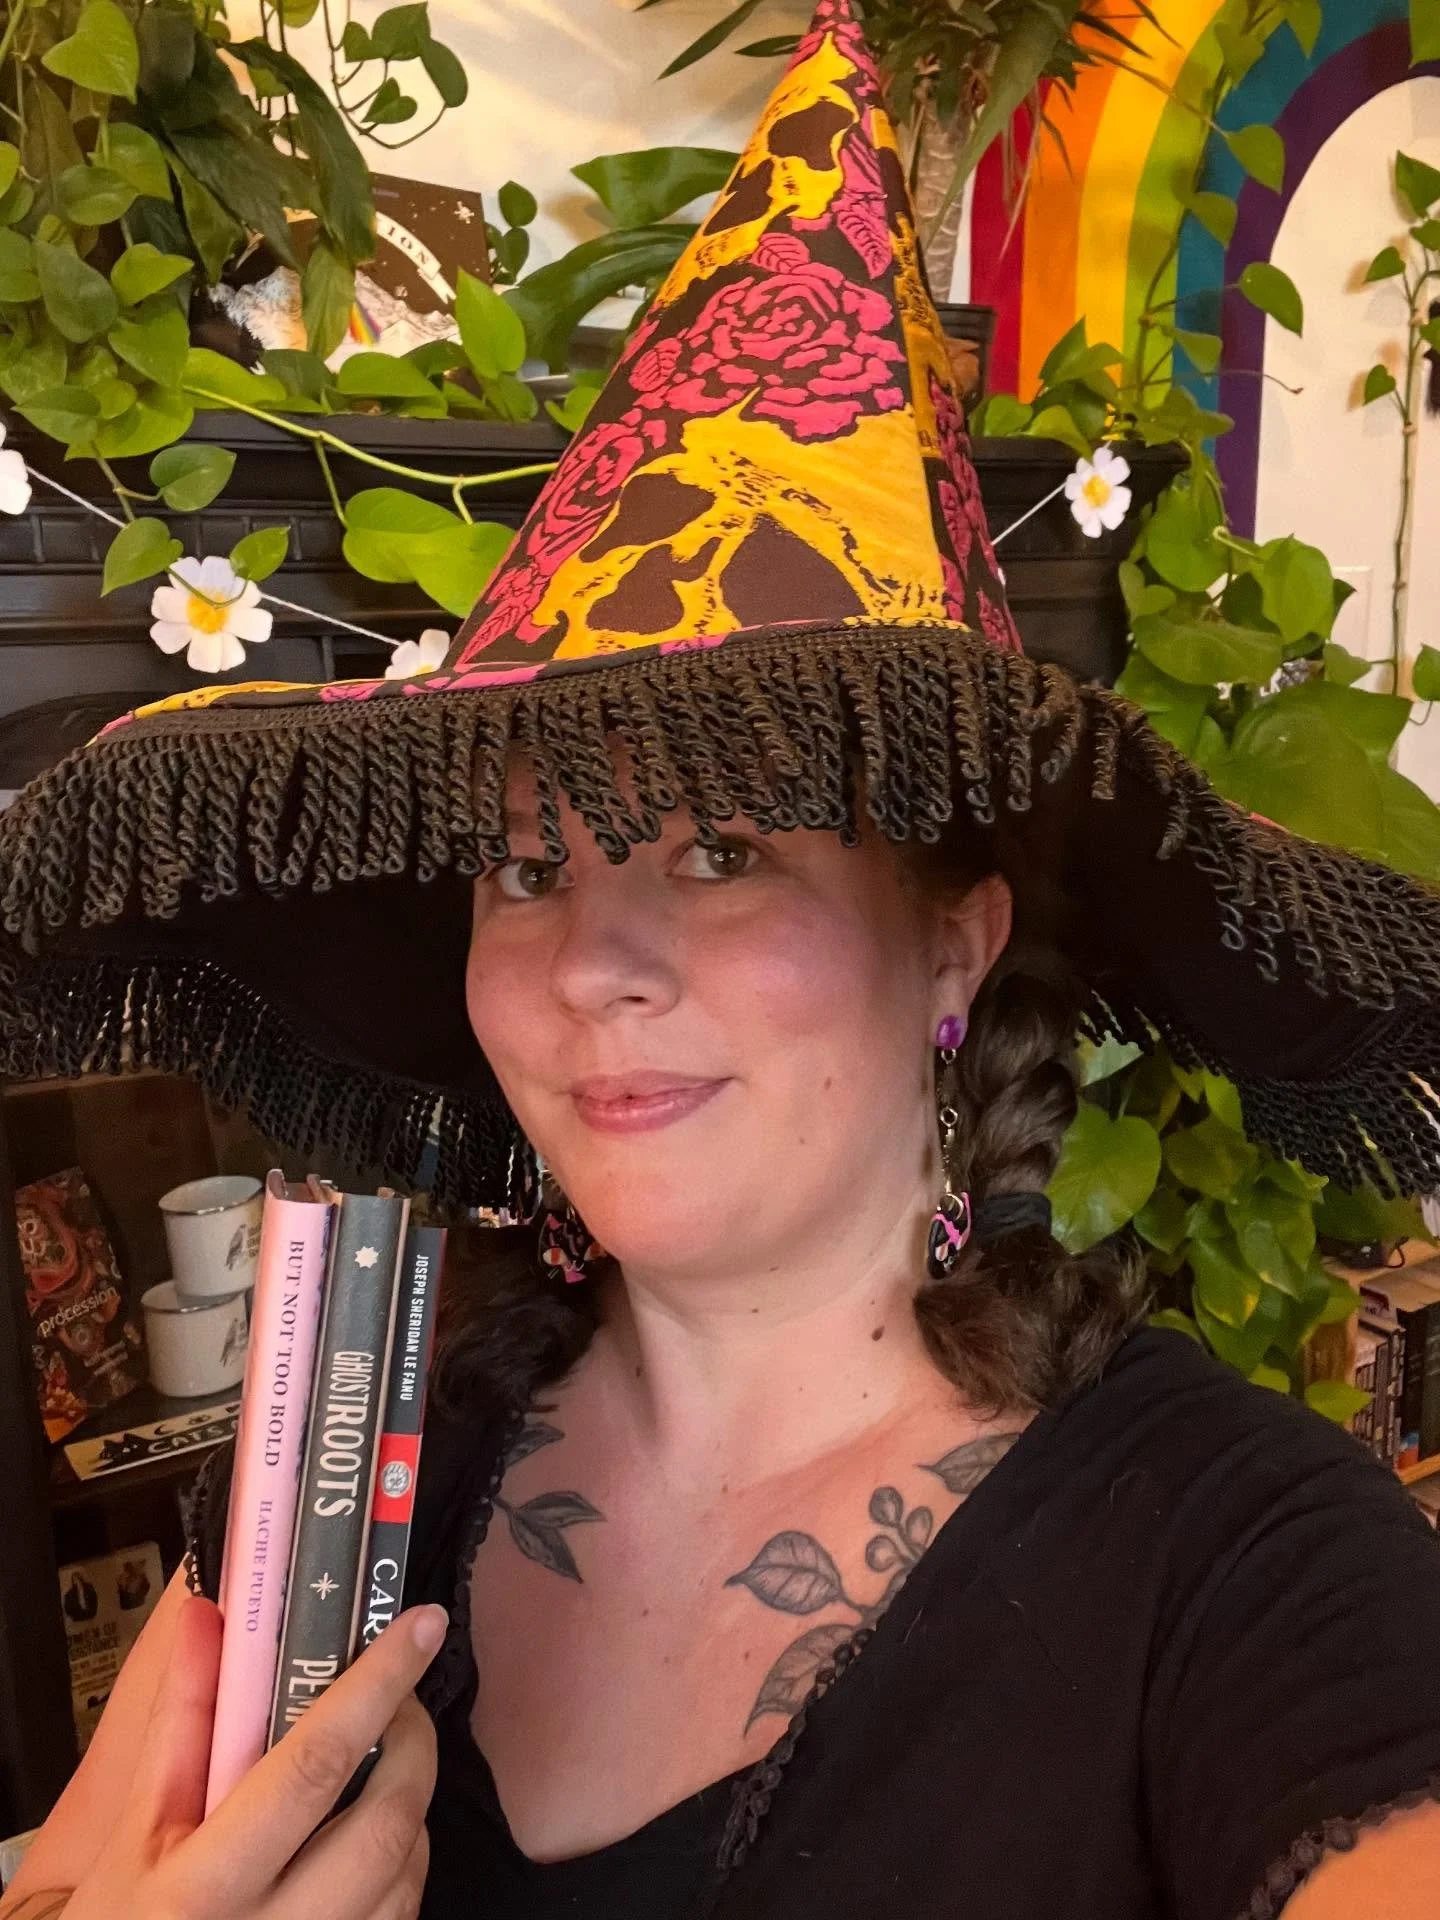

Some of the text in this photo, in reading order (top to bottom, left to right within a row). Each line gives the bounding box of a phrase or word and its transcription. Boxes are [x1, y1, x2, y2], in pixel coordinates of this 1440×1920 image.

[265, 1240, 304, 1466] BUT NOT TOO BOLD
[400, 1254, 430, 1401] JOSEPH SHERIDAN LE FANU
[313, 1350, 375, 1517] GHOSTROOTS
[254, 1500, 272, 1565] HACHE
[362, 1558, 399, 1645] CAR
